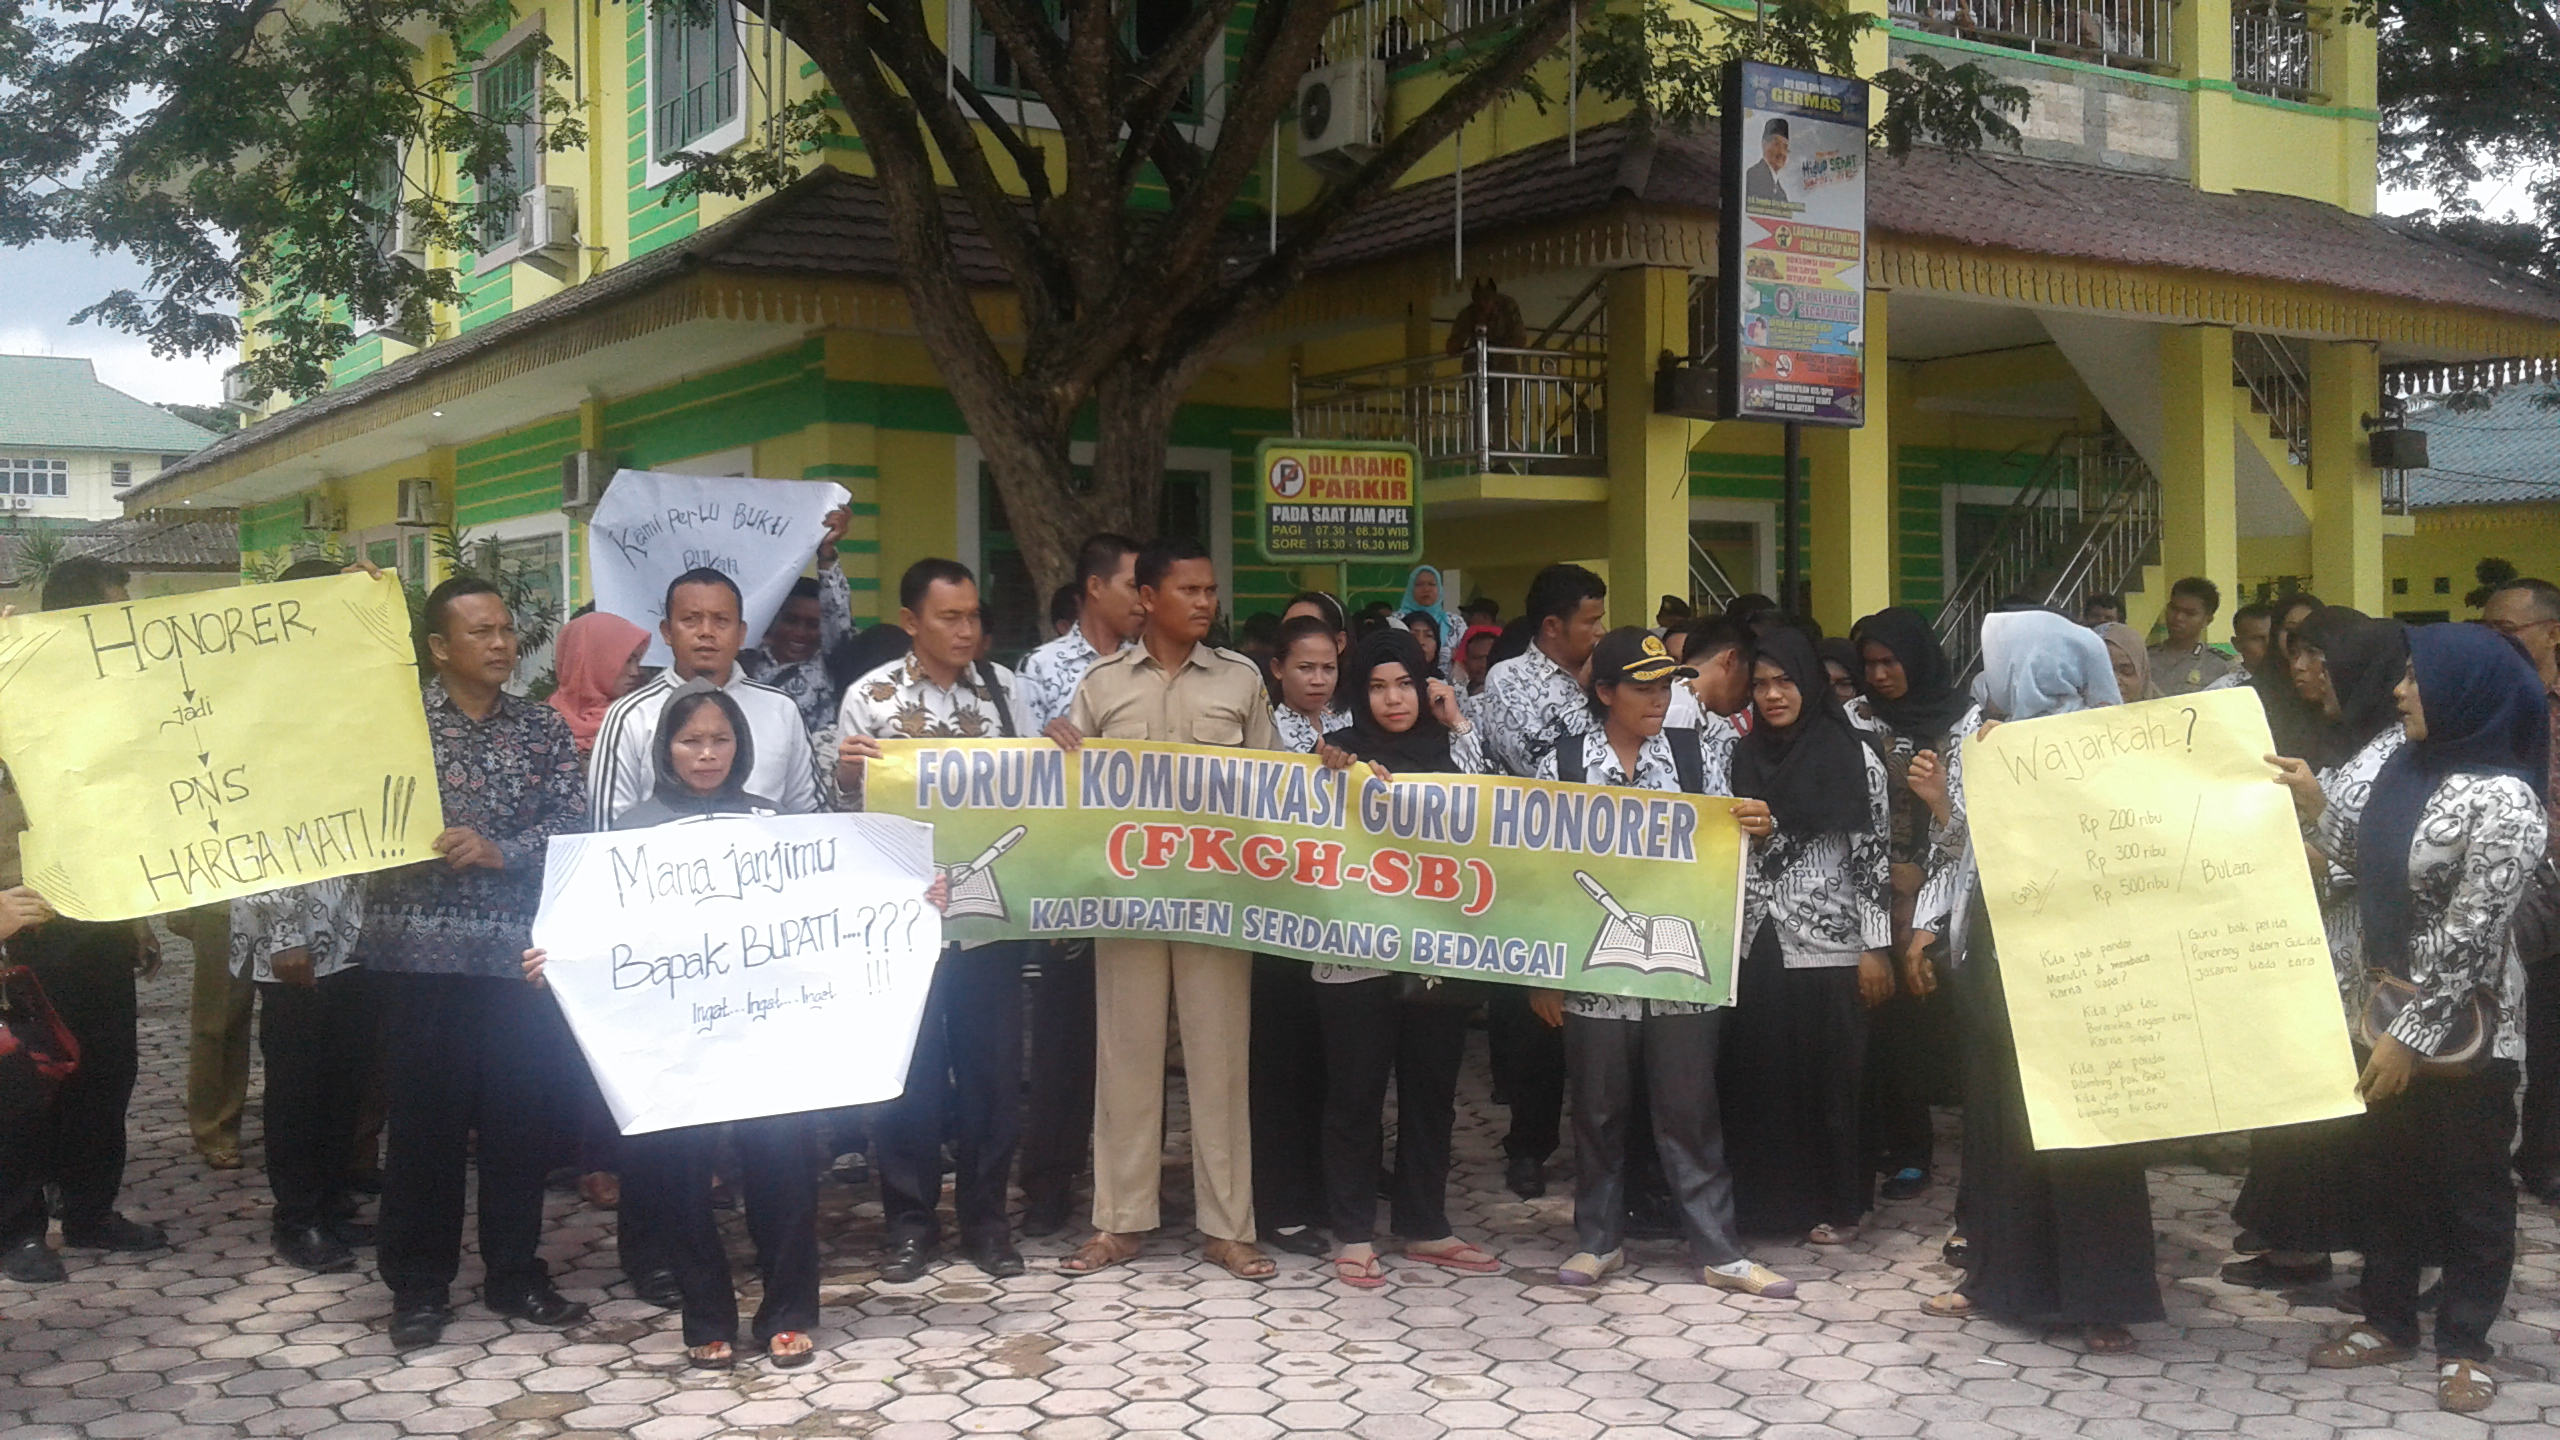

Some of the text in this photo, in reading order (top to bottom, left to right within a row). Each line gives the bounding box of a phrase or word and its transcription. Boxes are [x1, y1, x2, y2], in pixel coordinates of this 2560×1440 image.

[1771, 88, 1842, 113] GERMAS
[1308, 455, 1407, 478] DILARANG
[1309, 479, 1407, 500] PARKIR
[1272, 506, 1409, 524] PADA SAAT JAM APEL
[608, 514, 664, 571] Kami
[1272, 525, 1302, 536] PAGI
[1315, 525, 1346, 535] 07.30
[1355, 527, 1385, 536] 08.30
[1387, 527, 1410, 537] WIB
[1272, 539, 1307, 549] SORE
[1316, 539, 1346, 549] 15.30
[1356, 540, 1385, 550] 16.30
[1387, 540, 1410, 550] WIB
[78, 599, 317, 679] HONORER
[159, 697, 215, 734] jadi
[169, 764, 250, 815] PNS
[916, 748, 1698, 863] FORUM KOMUNIKASI GURU HONORER
[2079, 808, 2163, 841] Rp 200 ribu
[139, 830, 284, 902] HARGA
[1106, 822, 1498, 917] (FKGH-SB)
[2086, 842, 2166, 878] Rp 300 ribu
[605, 844, 717, 908] Mana
[2092, 884, 2112, 907] Rp
[2119, 877, 2145, 896] 500
[1029, 897, 1568, 979] KABUPATEN SERDANG BEDAGAI
[2188, 928, 2218, 940] Guru
[2227, 921, 2249, 934] bak
[611, 932, 731, 1000] Bapak
[2191, 943, 2240, 961] Penerang
[2048, 985, 2082, 1000] Karna
[2082, 1004, 2107, 1019] Kita
[2068, 1061, 2095, 1076] Kita
